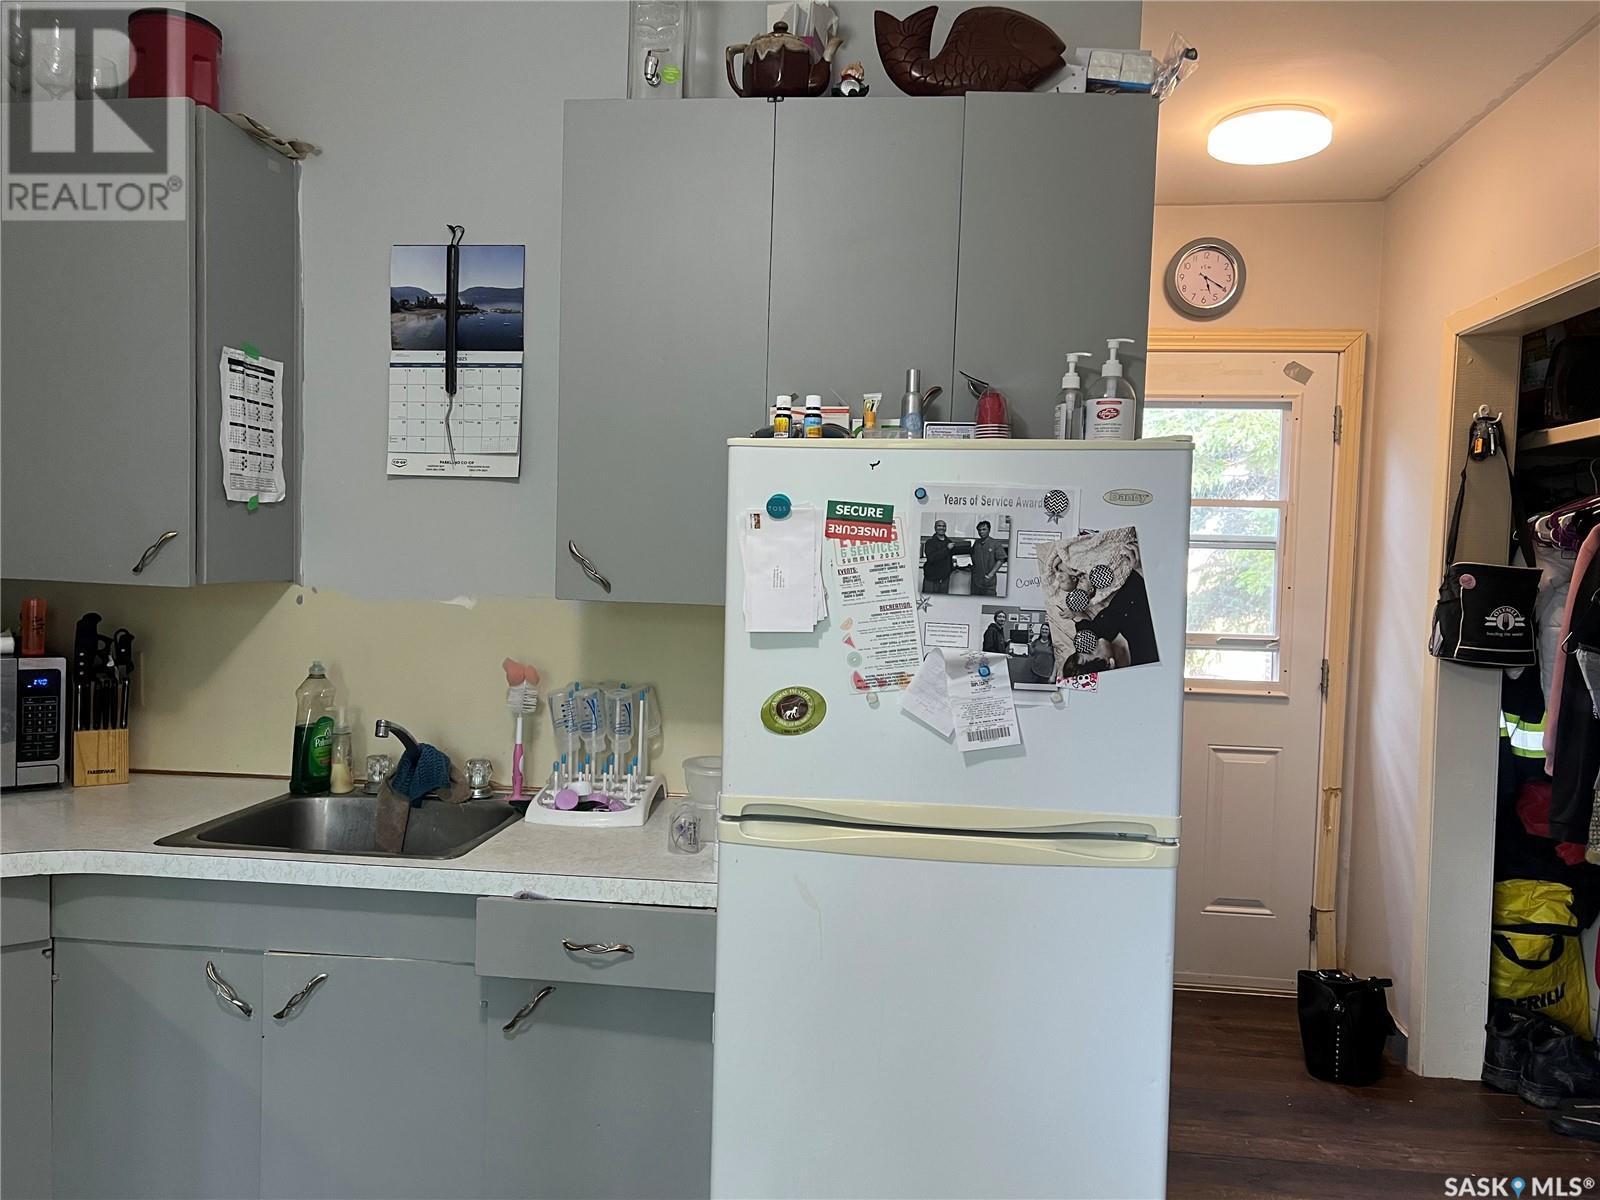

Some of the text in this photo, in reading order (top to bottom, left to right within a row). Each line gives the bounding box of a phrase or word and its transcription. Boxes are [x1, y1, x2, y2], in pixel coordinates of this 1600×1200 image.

[1204, 252, 1210, 260] 12
[1184, 262, 1191, 270] 10
[944, 494, 967, 506] Years
[969, 495, 978, 506] of
[981, 495, 1013, 507] Service
[836, 504, 884, 518] SECURE
[828, 524, 887, 538] UNSECURE
[850, 542, 900, 556] SERVICES
[842, 555, 875, 564] SUMMER
[1016, 577, 1041, 588] Cong
